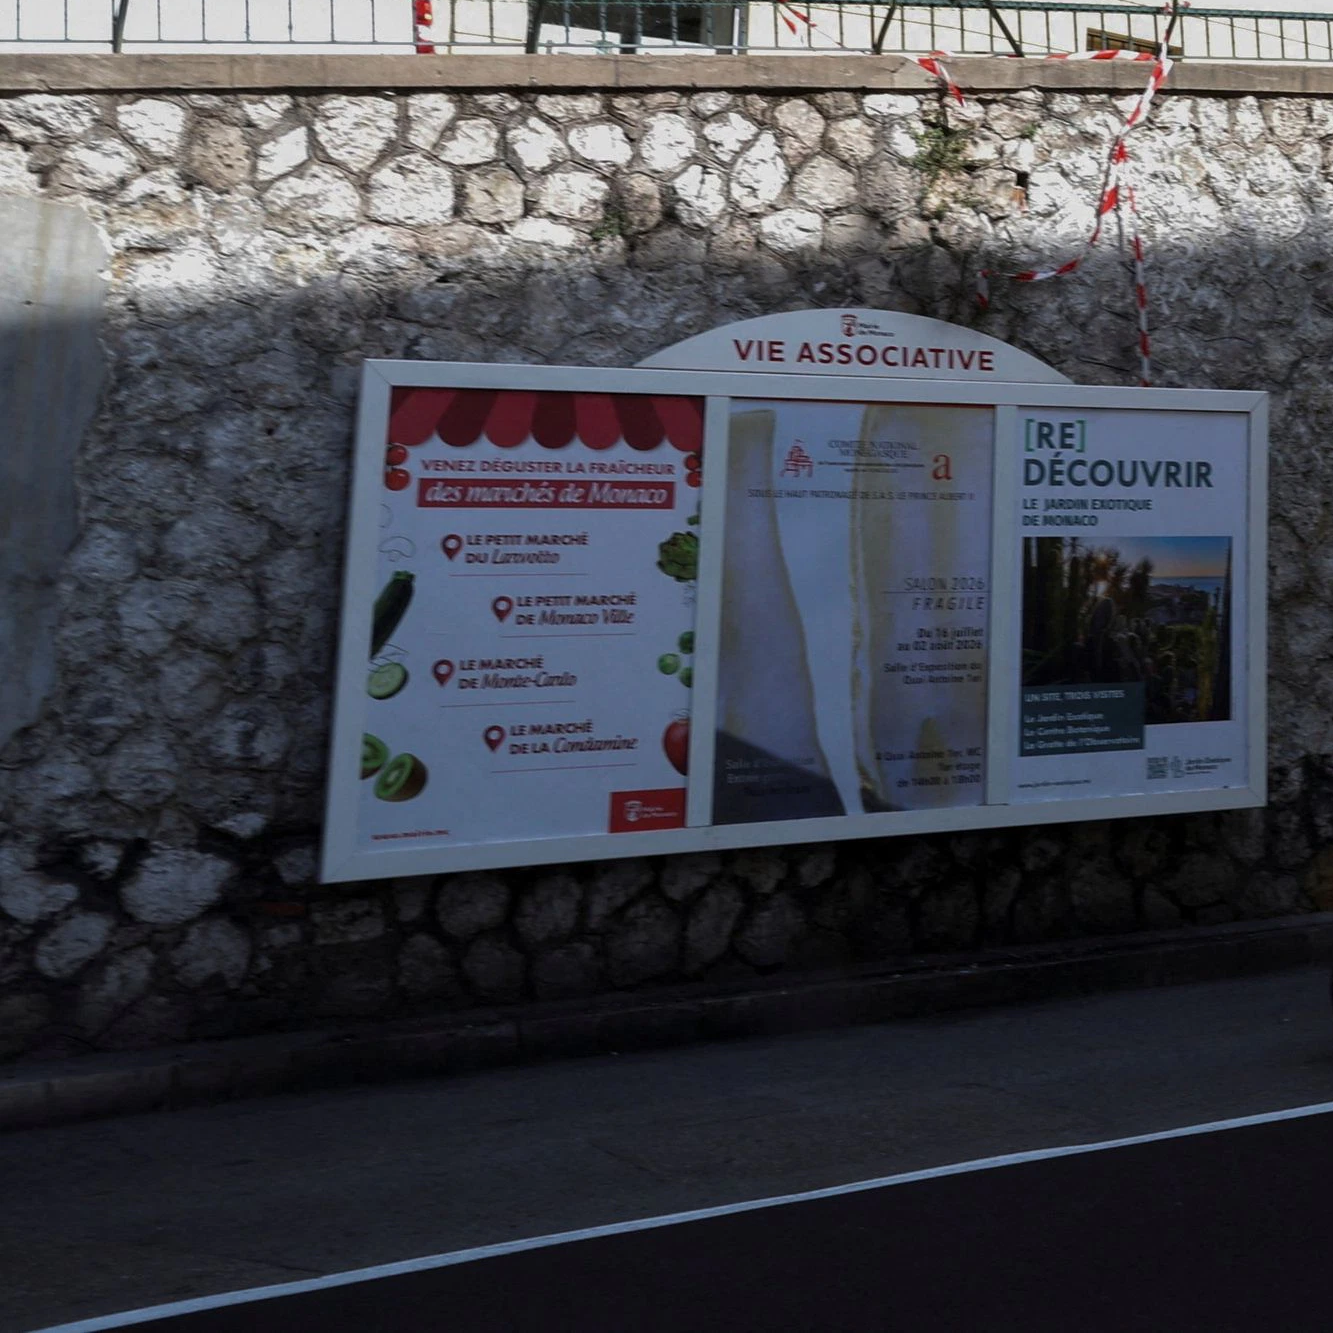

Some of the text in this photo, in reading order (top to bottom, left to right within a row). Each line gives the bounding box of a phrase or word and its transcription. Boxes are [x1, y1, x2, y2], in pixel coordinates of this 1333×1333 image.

[732, 339, 995, 371] VIE ASSOCIATIVE
[421, 456, 676, 475] VENEZ DÉGUSTER LA FRAÎCHEUR
[1023, 452, 1215, 488] DÉCOUVRIR
[426, 481, 668, 505] des marchés de Monaco
[1023, 499, 1153, 512] LE JARDIN EXOTIQUE
[1022, 515, 1099, 526] DE MONACO
[467, 531, 589, 546] LE PETIT MARCHÉ
[466, 553, 488, 564] DU
[517, 592, 637, 606] LE PETIT MARCHÉ
[911, 596, 985, 611] FRAGILE
[516, 609, 635, 625] DE Monaco Ville
[460, 655, 544, 671] LE MARCHÉ
[458, 672, 577, 690] DE Monte-Carlo
[510, 719, 593, 736] LE MARCHÉ
[509, 735, 639, 755] DE LA Condamine
